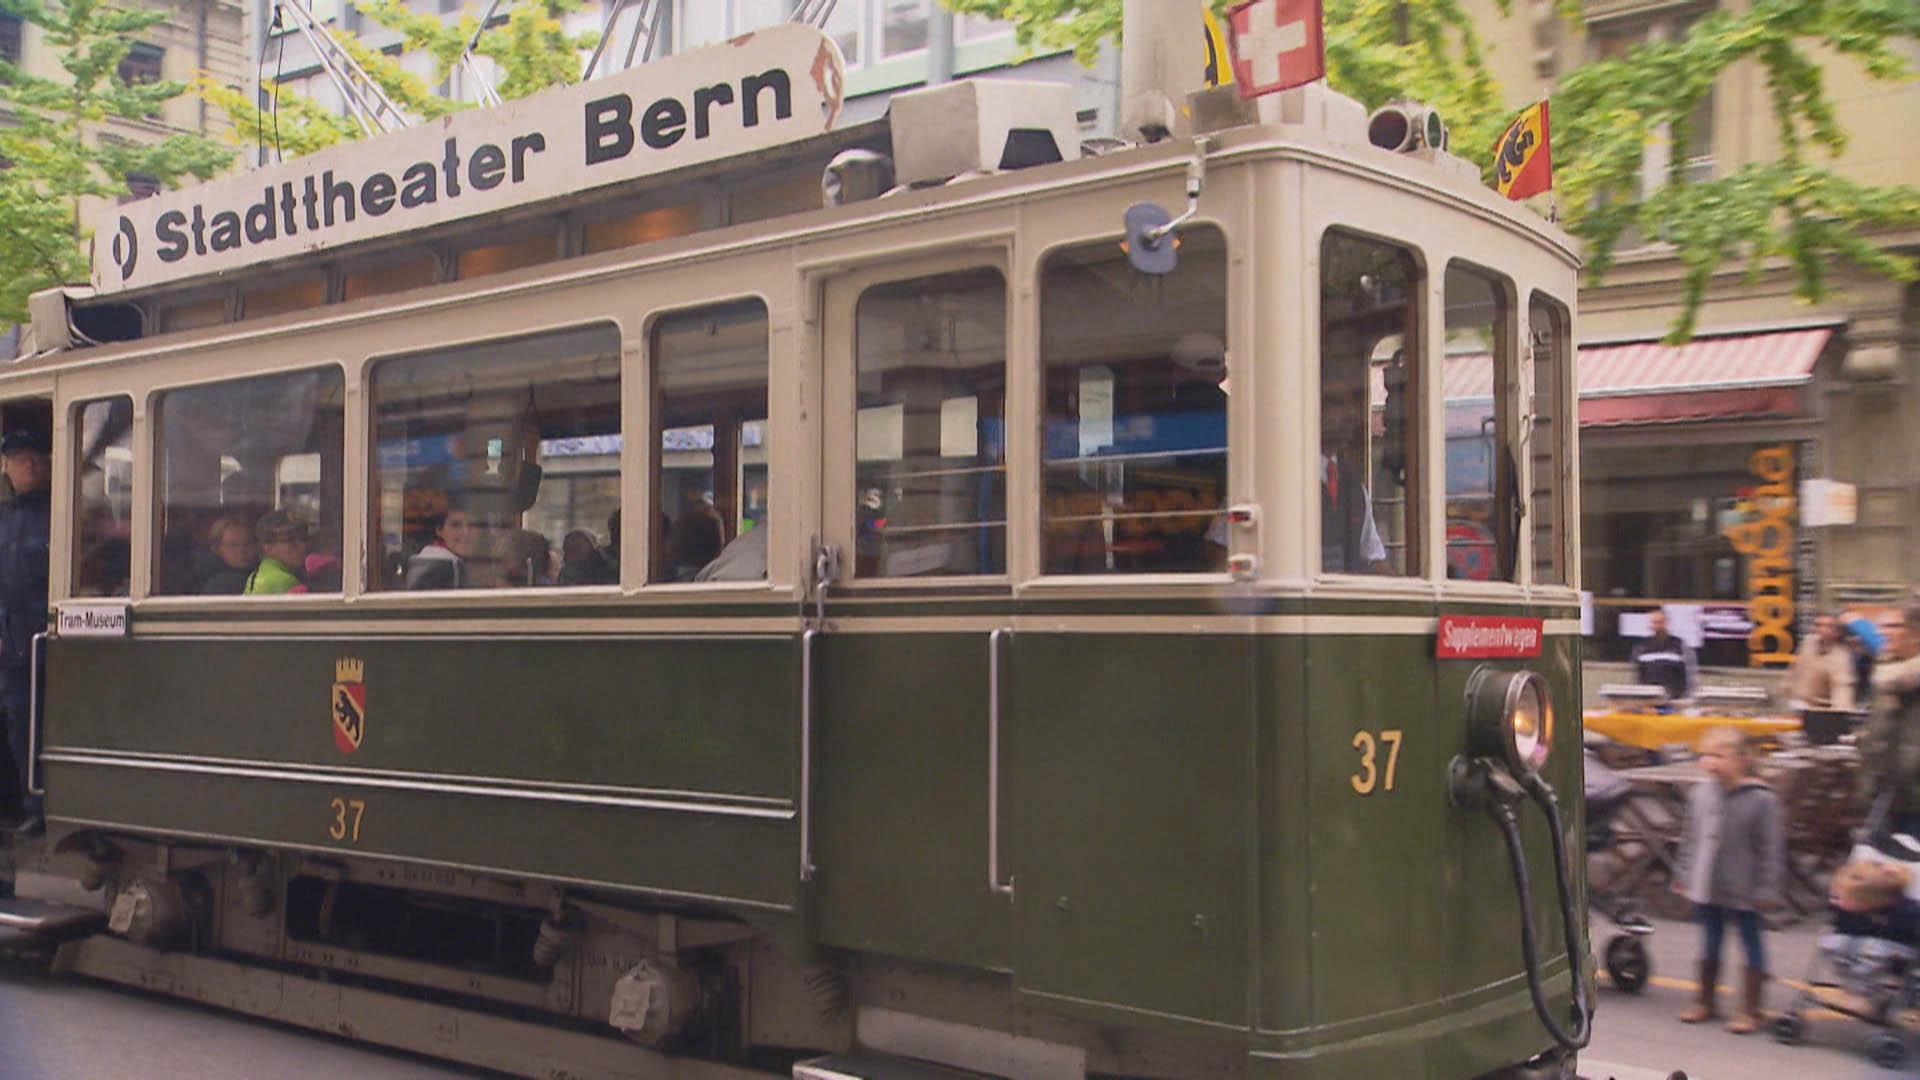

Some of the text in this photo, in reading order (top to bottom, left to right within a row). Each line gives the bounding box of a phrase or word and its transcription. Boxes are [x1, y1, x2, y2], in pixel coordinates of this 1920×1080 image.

[155, 66, 792, 263] Stadttheater Bern
[60, 610, 125, 630] Tram-Museum
[1351, 730, 1402, 794] 37
[329, 798, 365, 842] 37
